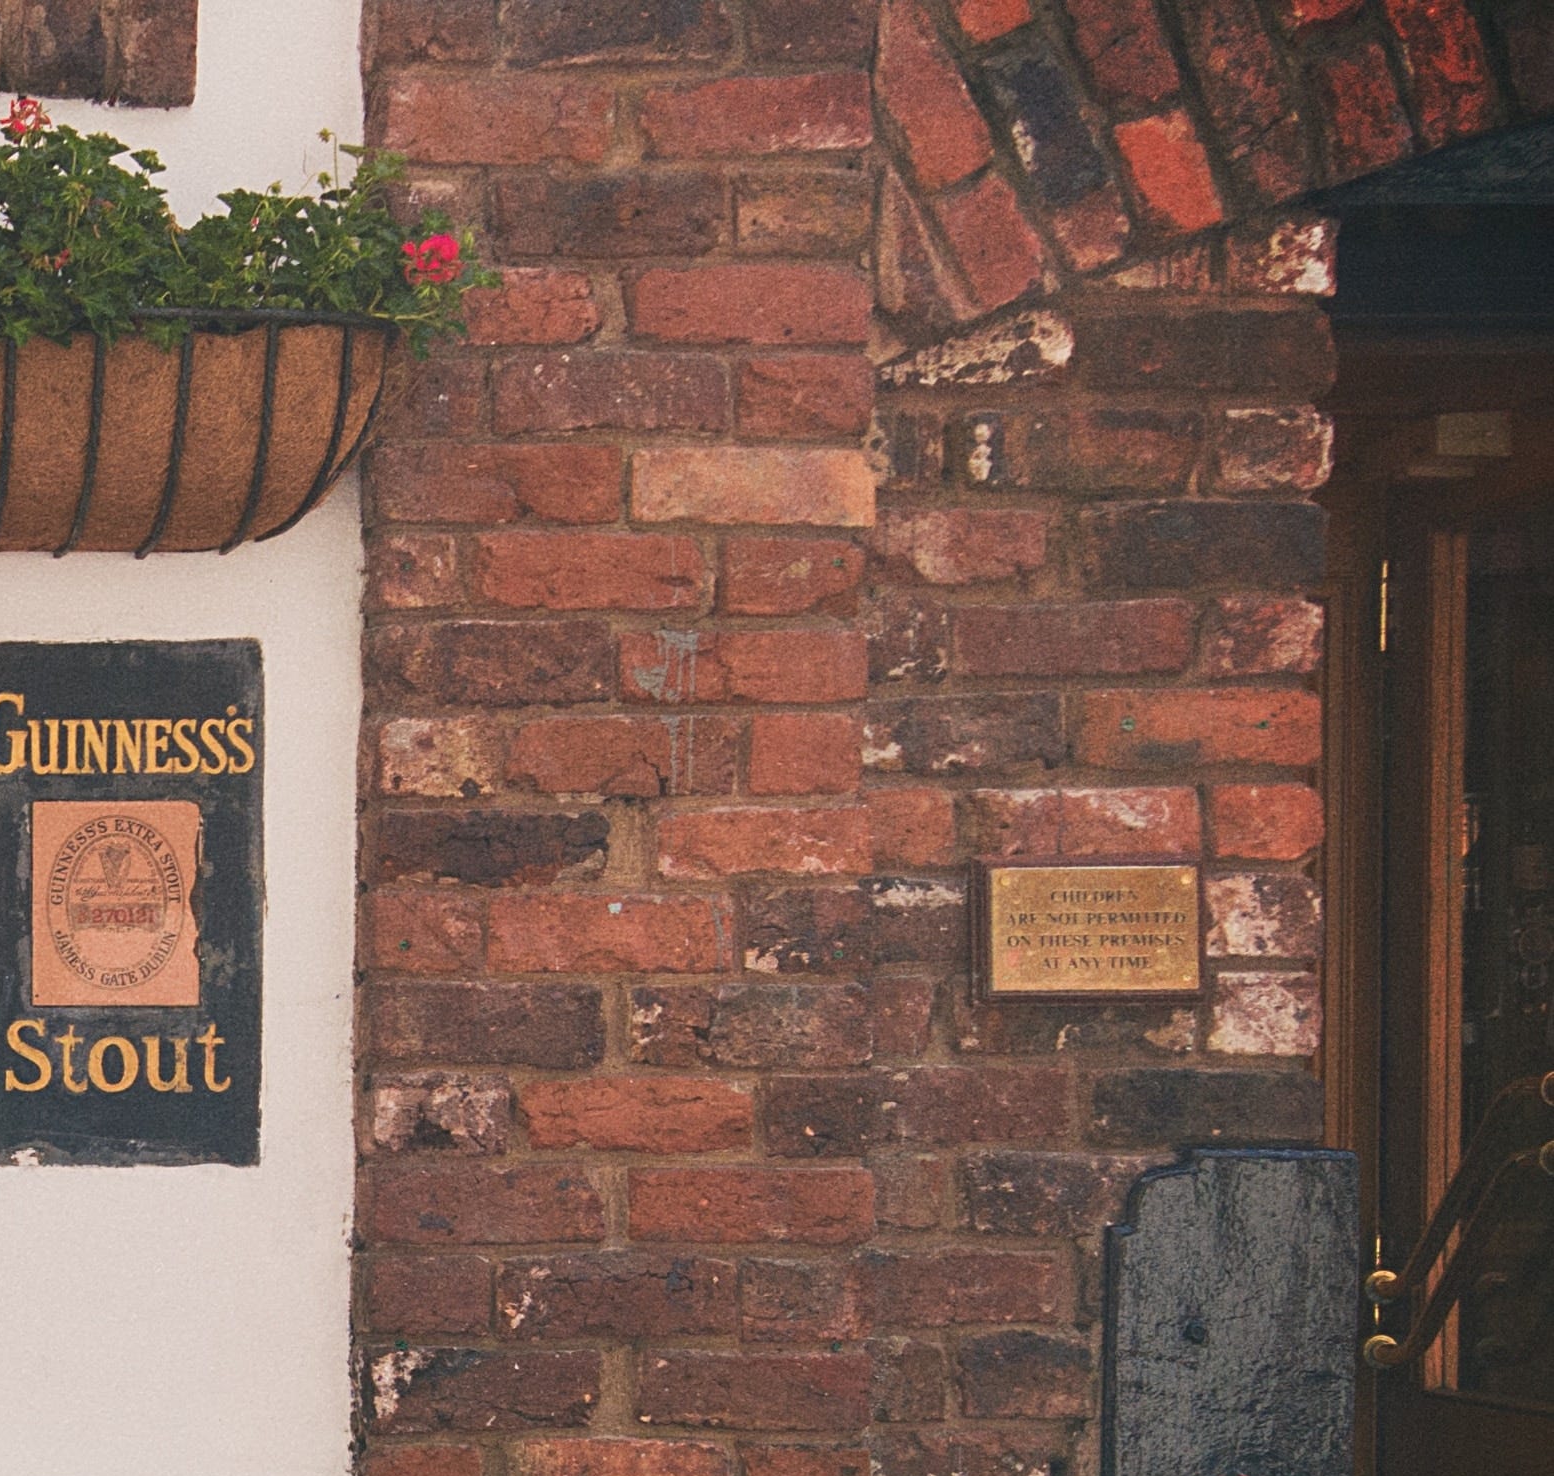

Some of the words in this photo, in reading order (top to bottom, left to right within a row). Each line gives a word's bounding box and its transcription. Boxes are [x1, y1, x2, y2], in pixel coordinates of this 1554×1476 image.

[114, 818, 164, 852] EXTRA
[159, 852, 182, 904] STOUT
[1006, 912, 1037, 926] ARE
[1046, 912, 1080, 925] NOT
[1086, 911, 1187, 925] PERMITTED
[100, 970, 139, 986] GATE
[138, 930, 177, 979] DUBLIN
[1006, 935, 1031, 948] ON
[1038, 934, 1093, 948] THESE
[1099, 933, 1185, 947] PREMISES
[1042, 956, 1062, 970] AT
[1068, 956, 1100, 970] ANY
[1108, 956, 1152, 969] TIME
[5, 1018, 231, 1093] Stout
